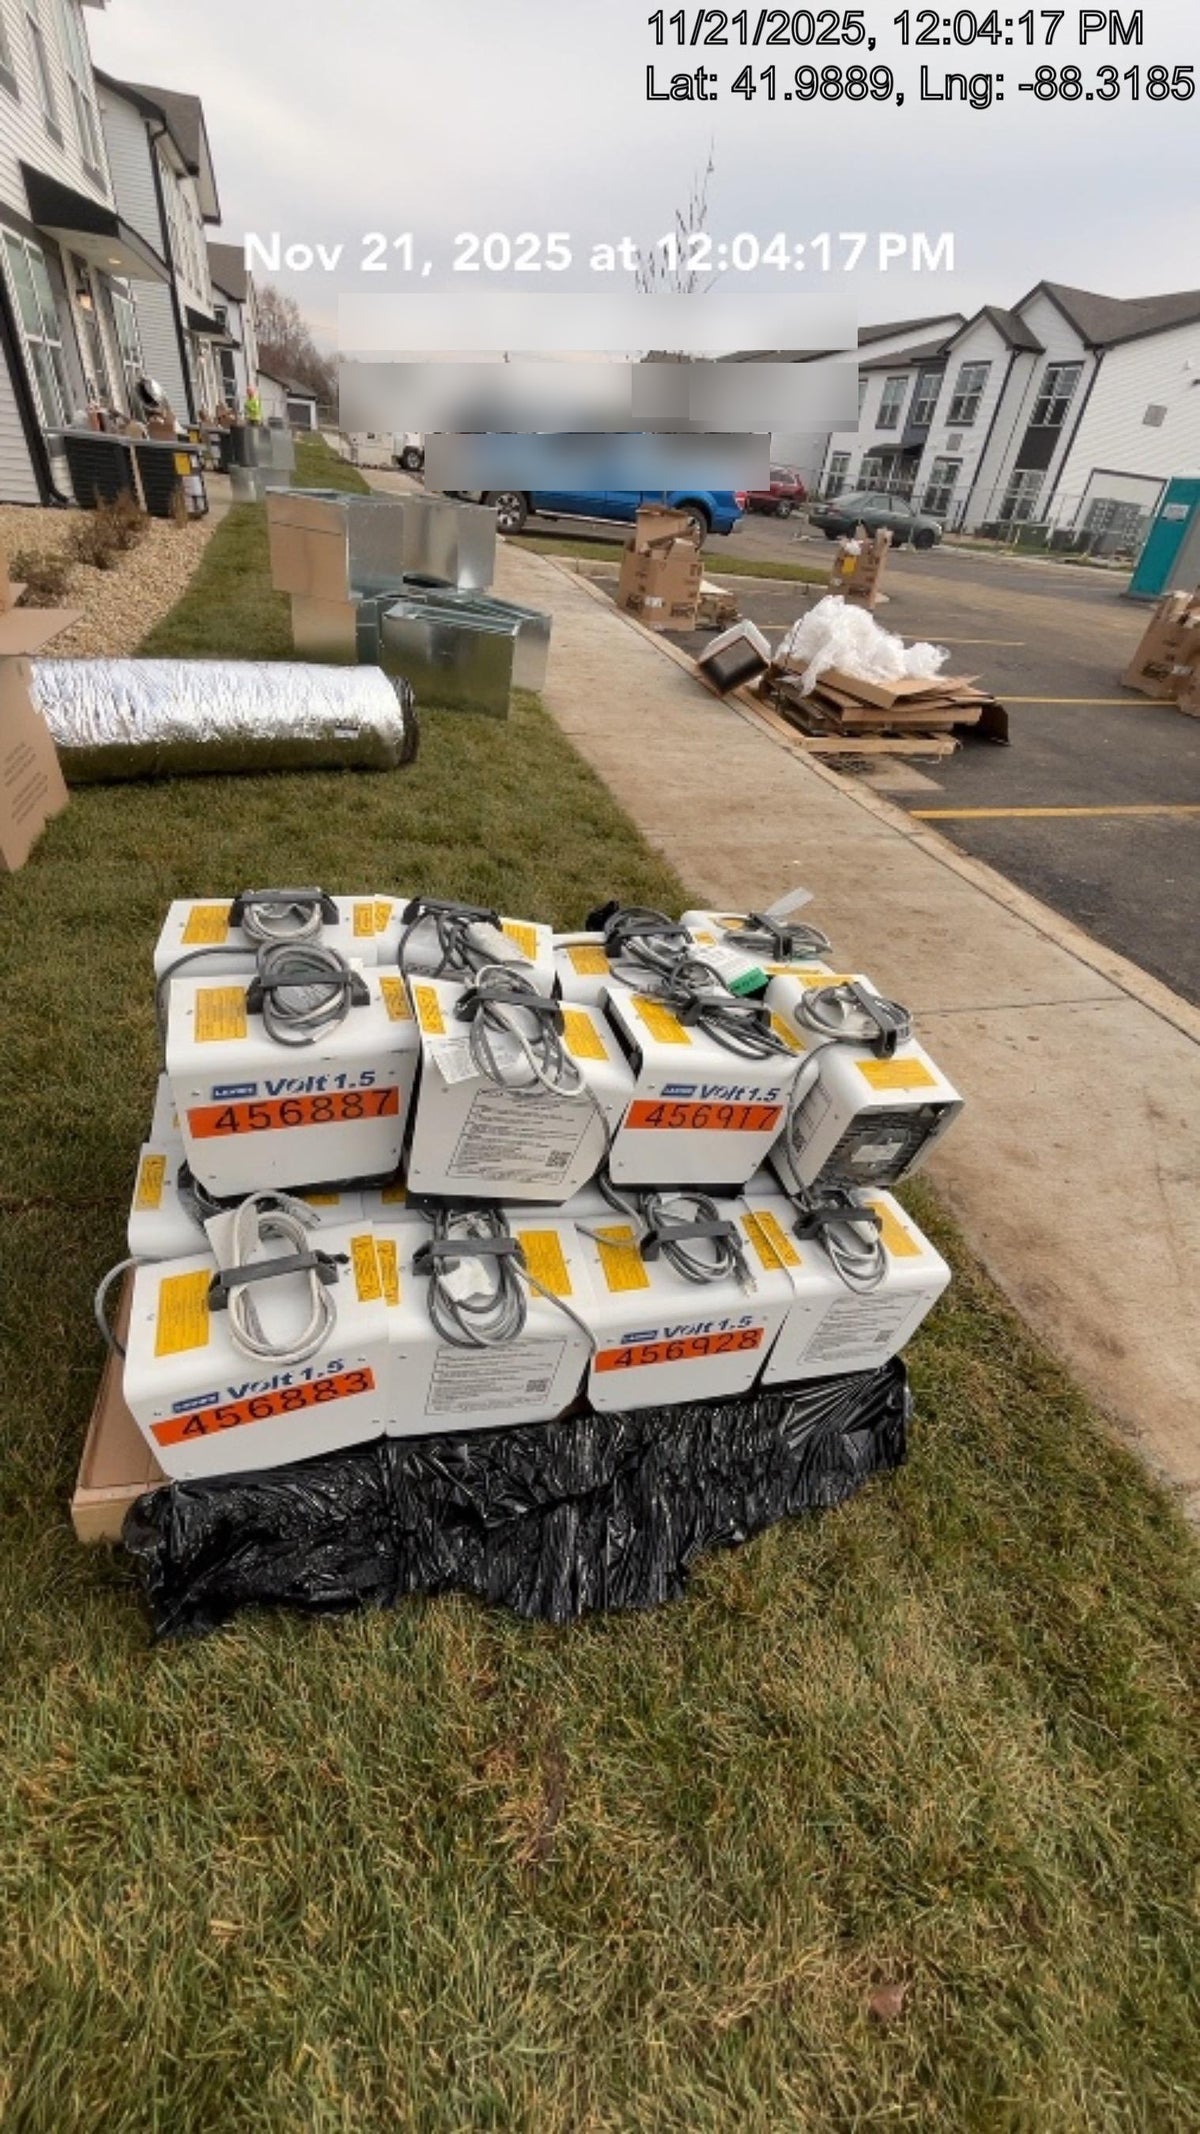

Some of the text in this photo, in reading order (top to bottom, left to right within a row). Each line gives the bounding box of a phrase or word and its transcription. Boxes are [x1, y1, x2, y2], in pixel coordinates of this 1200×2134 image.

[264, 1074, 329, 1096] Volt
[333, 1071, 376, 1089] 1.5
[701, 1084, 746, 1100] Volt
[748, 1087, 781, 1101] 1.5
[215, 1089, 392, 1132] 456887
[645, 1103, 779, 1129] 456917
[664, 1322, 714, 1338] Volt
[718, 1315, 752, 1331] 1.5
[614, 1330, 759, 1367] 456928
[227, 1358, 344, 1400] Volt 1.5
[182, 1370, 369, 1436] 456883
